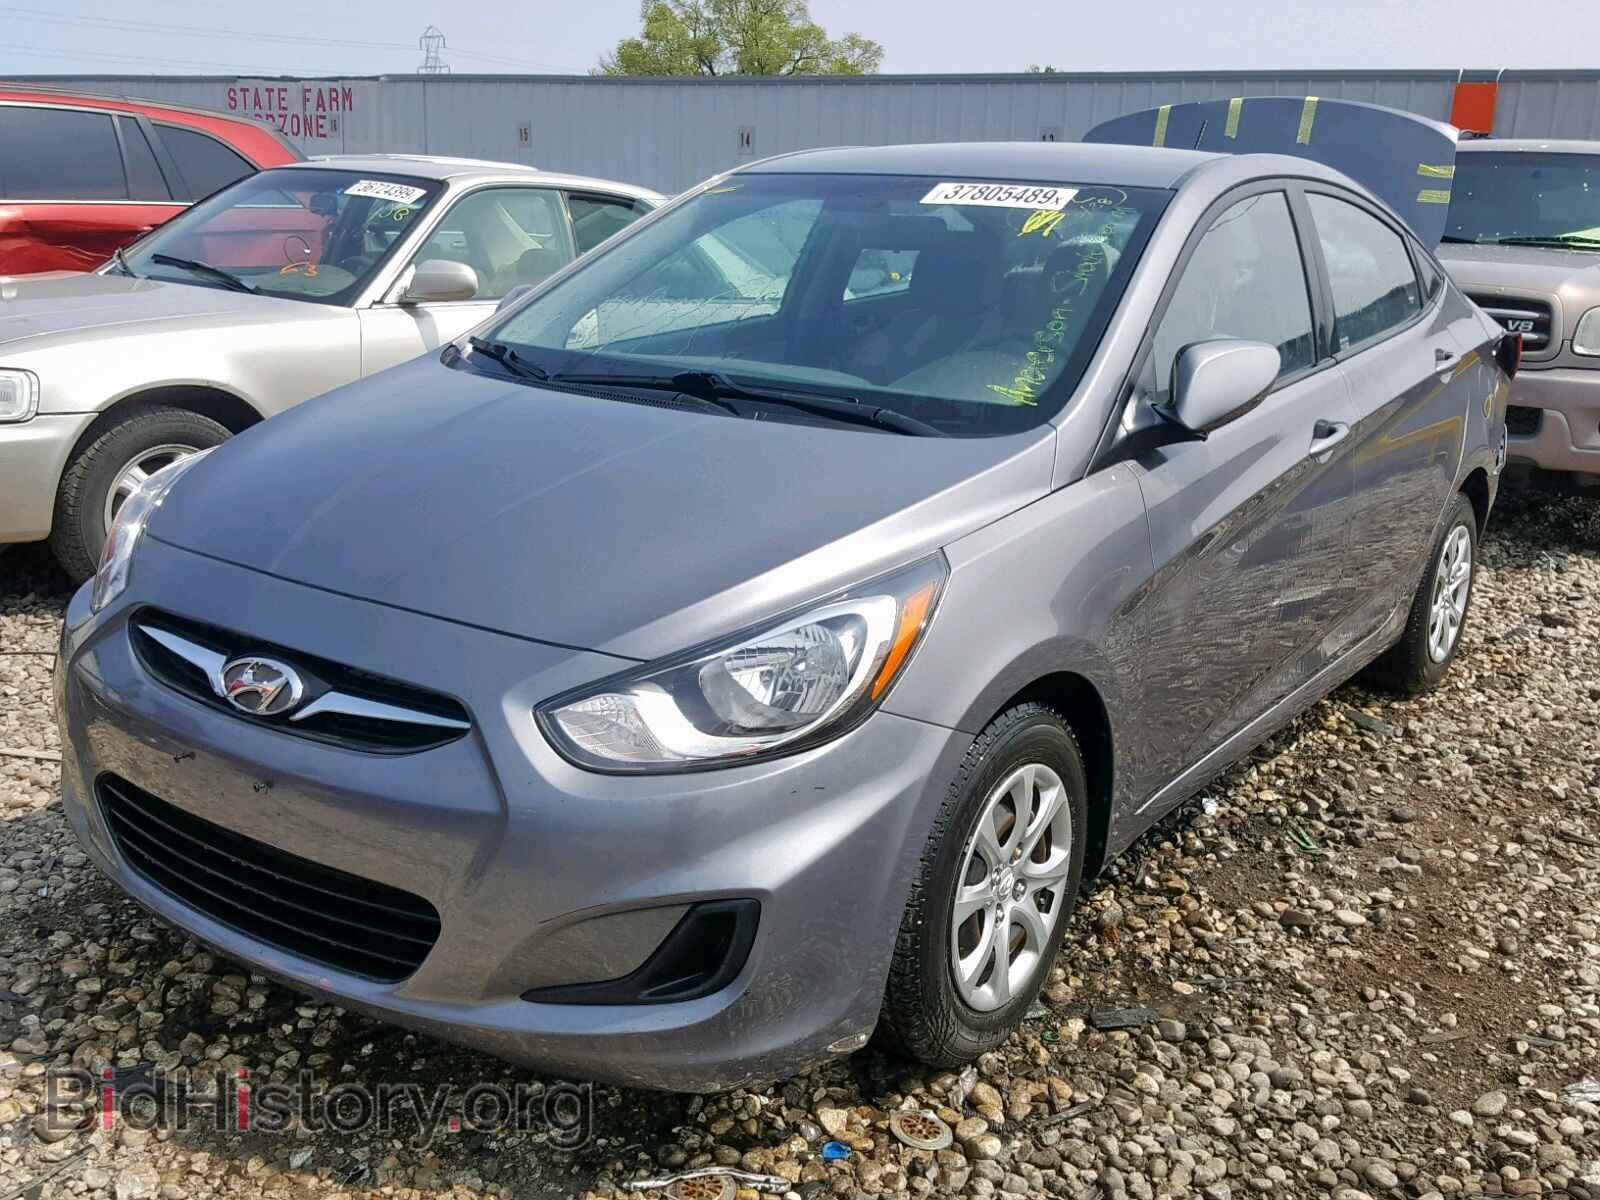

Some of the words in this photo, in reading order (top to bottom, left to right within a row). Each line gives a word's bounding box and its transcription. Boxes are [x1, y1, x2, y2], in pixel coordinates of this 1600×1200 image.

[227, 87, 289, 111] STATE
[303, 87, 354, 112] FARM
[740, 132, 752, 148] 14
[1508, 319, 1535, 332] V8
